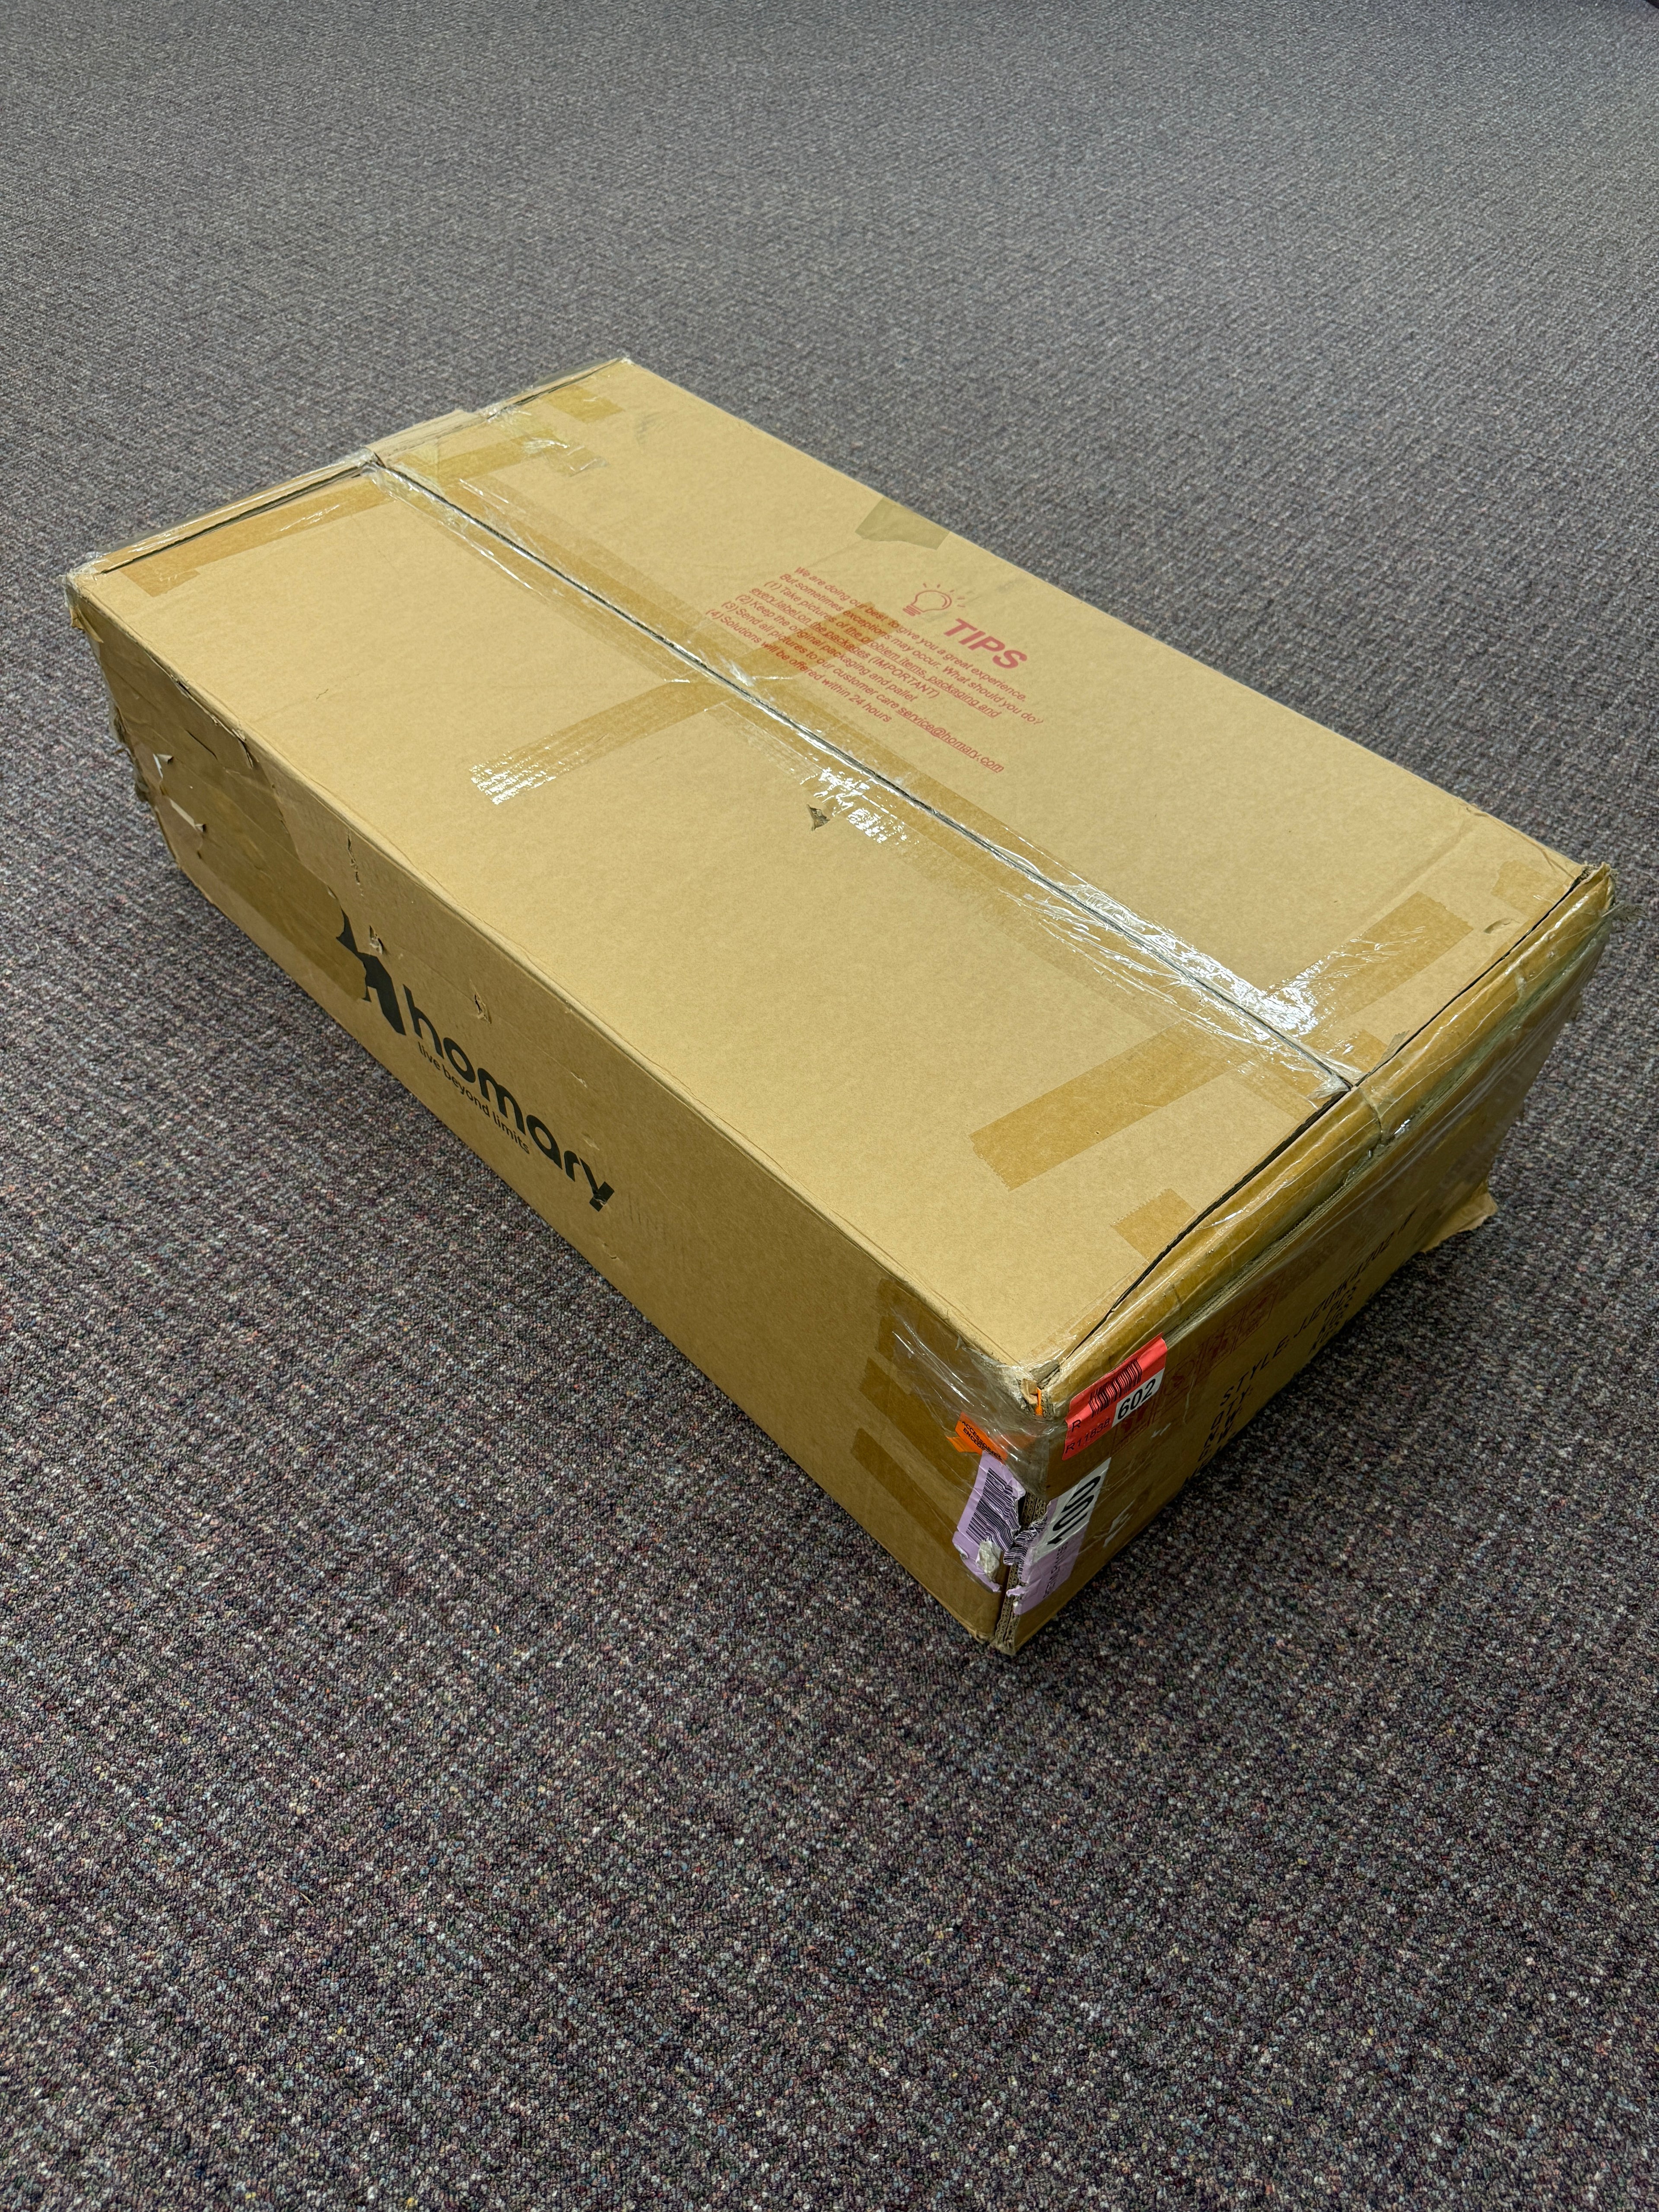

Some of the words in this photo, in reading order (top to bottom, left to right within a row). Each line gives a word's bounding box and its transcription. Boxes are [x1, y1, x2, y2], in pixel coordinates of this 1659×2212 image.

[705, 609, 724, 619] (4)
[720, 616, 762, 643] Solutions
[761, 642, 780, 653] will
[775, 649, 790, 661] be
[788, 659, 825, 680] offered
[821, 678, 851, 697] within
[848, 694, 866, 706] 24
[861, 702, 892, 722] hours
[721, 601, 739, 612] (3)
[735, 608, 763, 625] Send
[758, 623, 775, 632] all
[767, 630, 807, 654] pictures
[805, 651, 817, 659] to
[816, 658, 834, 669] our
[833, 668, 878, 695] customer
[876, 694, 899, 709] care
[895, 707, 1004, 773] service@homary.com
[735, 594, 753, 604] (2)
[750, 601, 775, 617] Keep
[773, 615, 790, 626] the
[789, 626, 825, 646] original
[819, 645, 871, 675] packaging
[868, 673, 892, 686] and
[885, 684, 918, 702] pallet
[749, 588, 776, 604] every
[772, 601, 801, 617] label
[794, 615, 811, 623] on
[809, 622, 827, 634] the
[822, 631, 870, 658] packages
[868, 657, 940, 699] (IMPORTANT)
[763, 580, 782, 590] (1)
[780, 587, 801, 601] Take
[797, 601, 837, 623] pictures
[843, 626, 862, 639] the
[859, 636, 900, 661] problem
[925, 676, 979, 707] packaging
[976, 704, 1002, 718] and
[779, 573, 798, 585] But
[795, 582, 843, 611] sometimes
[842, 610, 890, 639] exceptions
[891, 638, 914, 652] may
[912, 650, 941, 668] occur.
[942, 665, 971, 683] What
[967, 682, 1005, 702] should
[998, 700, 1022, 714] you
[1020, 712, 1044, 725] do?
[794, 566, 810, 577] We
[808, 575, 826, 586] are
[824, 585, 851, 601] doing
[849, 599, 870, 609] our
[864, 605, 888, 621] best
[887, 620, 901, 629] to
[896, 625, 920, 640] give
[915, 638, 939, 651] you
[942, 653, 973, 670] great
[970, 667, 1026, 702] experience.
[944, 618, 1027, 668] TIPS
[403, 984, 615, 1212] homary
[418, 1041, 441, 1071] live
[442, 1064, 490, 1118] beyond
[493, 1111, 530, 1154] limits
[1117, 1378, 1156, 1420] 602
[1211, 1384, 1253, 1430] QTY:
[1220, 1334, 1290, 1406] STYLE:
[1065, 1417, 1111, 1454] R11838
[1071, 1419, 1081, 1433] R
